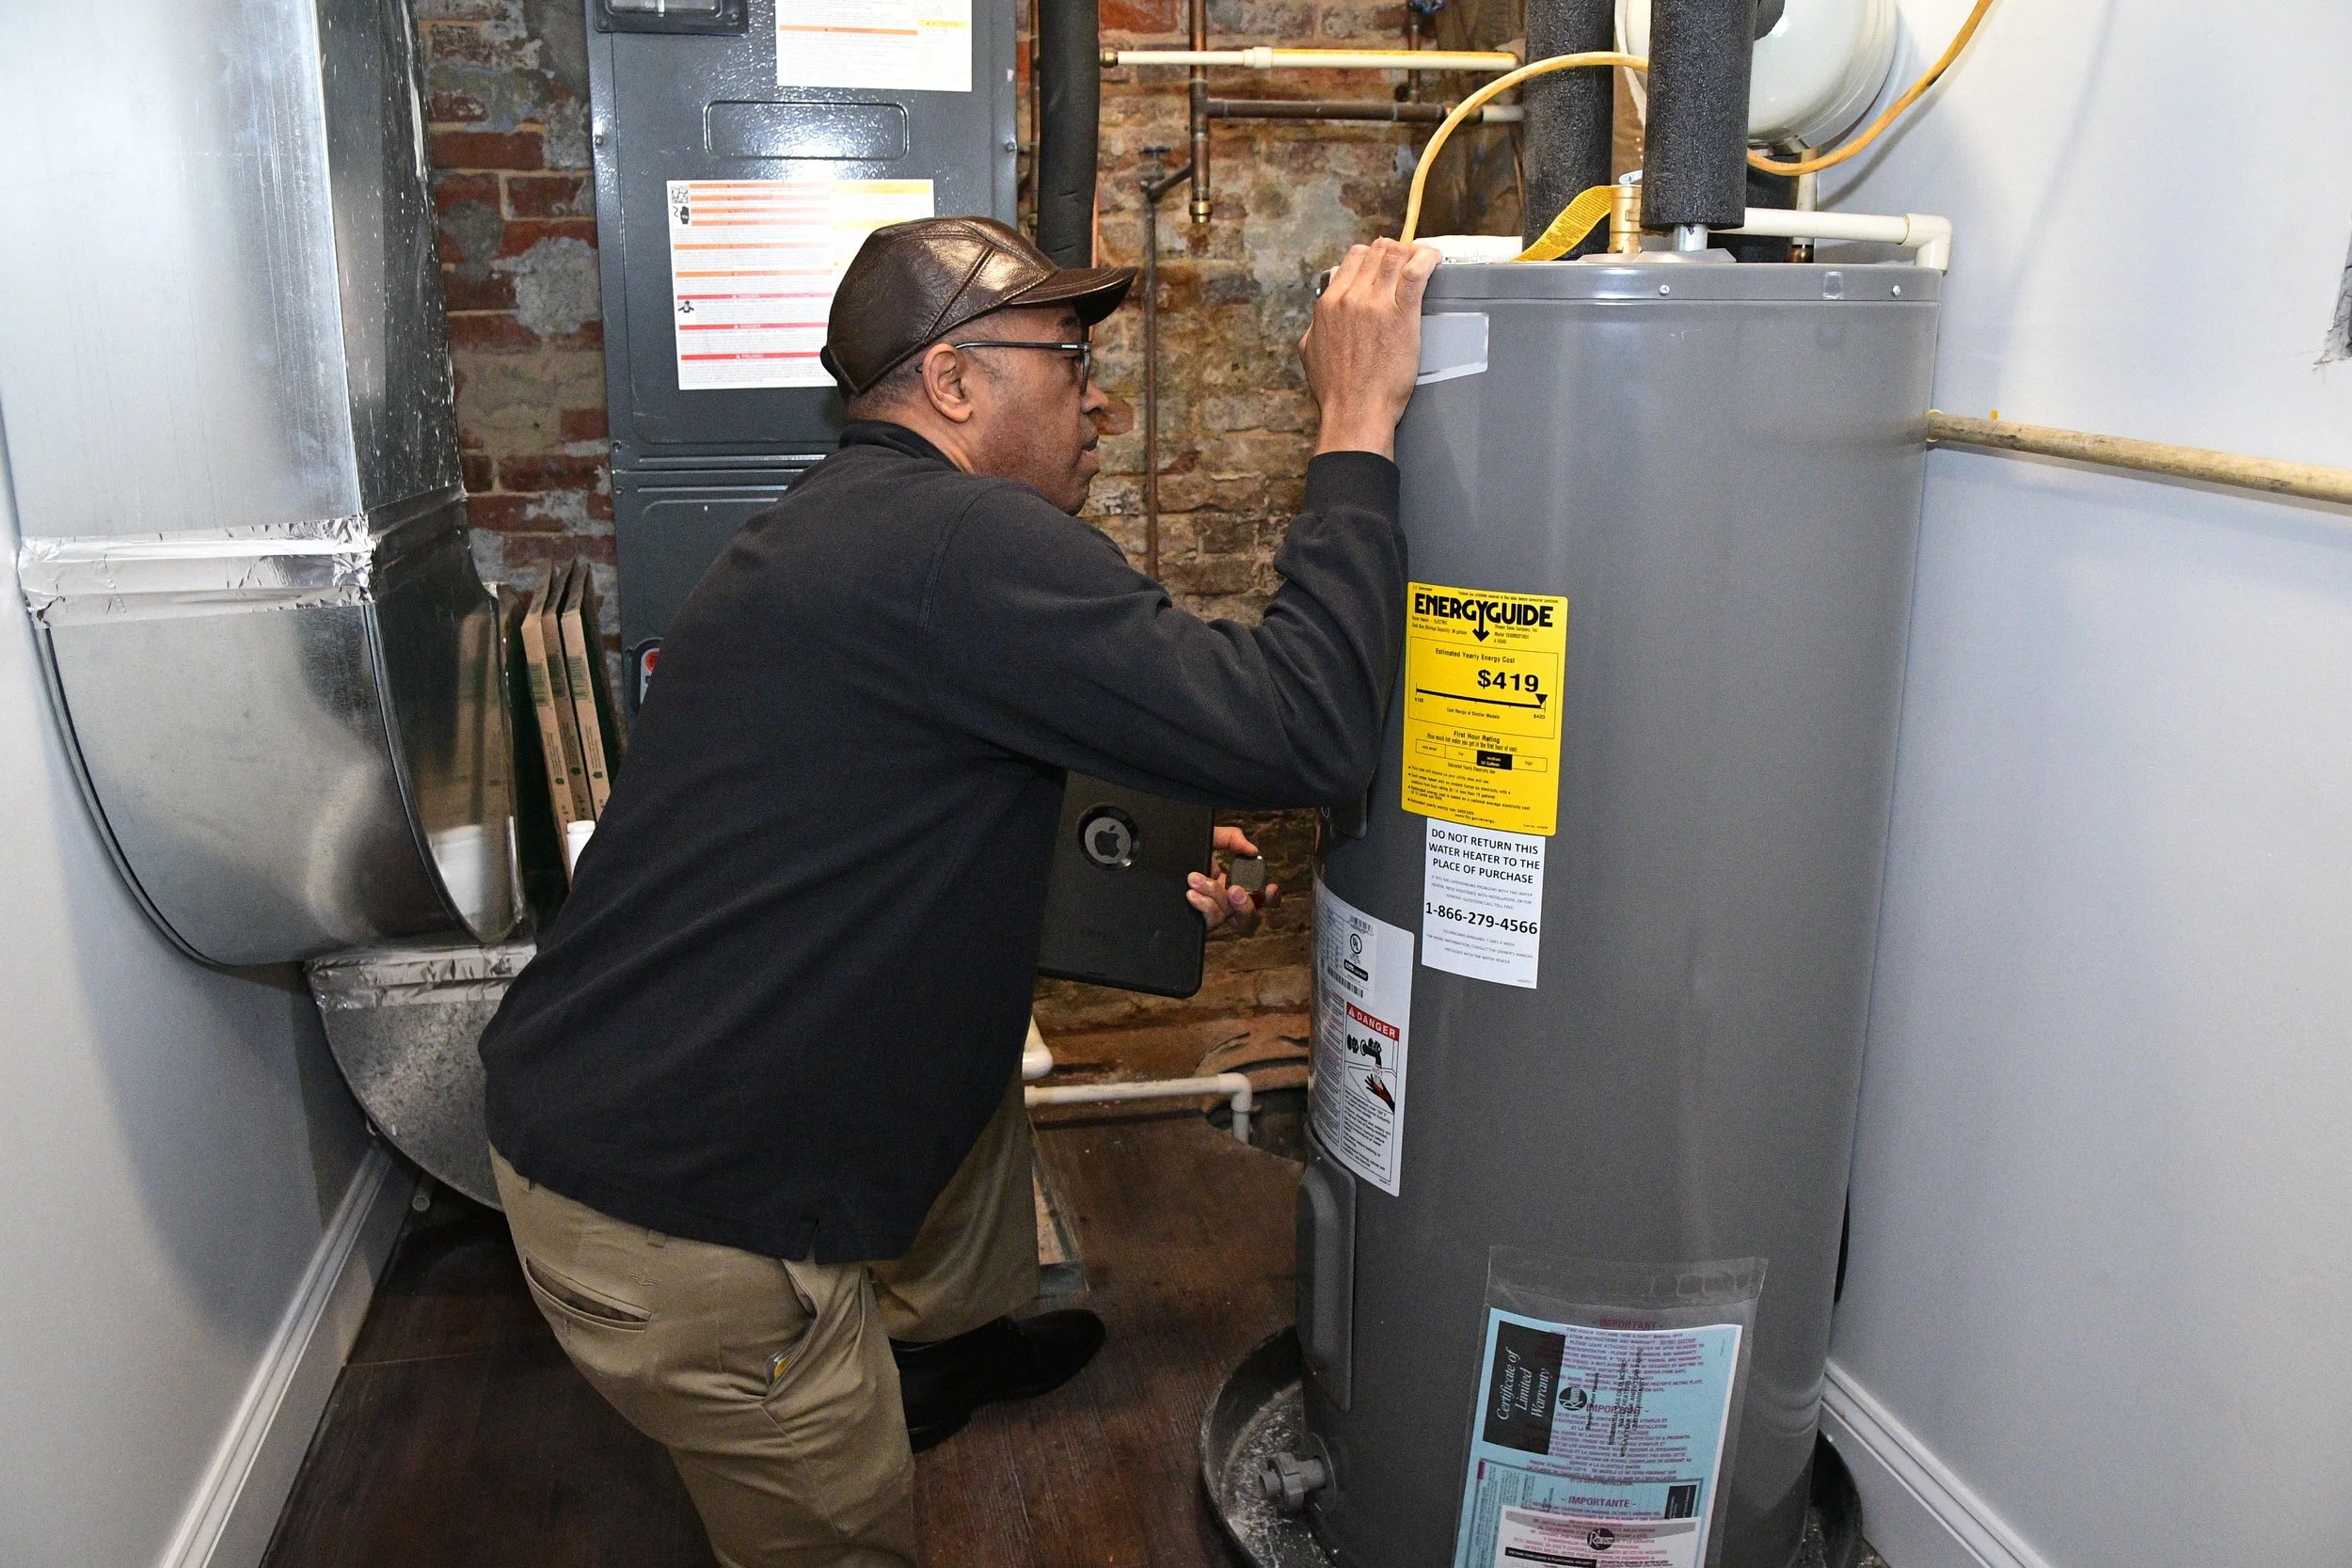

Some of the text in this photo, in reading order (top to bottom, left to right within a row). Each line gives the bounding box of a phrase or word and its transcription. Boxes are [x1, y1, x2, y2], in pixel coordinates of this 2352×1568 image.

[1415, 593, 1553, 628] ENERGYGUIDE
[1436, 648, 1460, 657] Estimated
[1462, 651, 1479, 661] Yearly
[1481, 653, 1501, 663] Energy
[1477, 669, 1539, 693] $419
[1482, 735, 1501, 744] Rating
[1431, 829, 1538, 855] DO NOT RETURN THIS
[1428, 842, 1540, 870] WATER HEATER TO THE
[1433, 858, 1534, 884] PLACE OF PURCHASE
[1425, 901, 1537, 934] 1-866-279-4566
[1357, 1011, 1395, 1038] DANGER
[1372, 1067, 1383, 1077] HOT
[1599, 1319, 1657, 1330] IMPORTANT
[1497, 1346, 1521, 1420] Certificate of
[1515, 1367, 1533, 1411] Limited
[1531, 1368, 1553, 1418] Warranty
[1559, 1386, 1583, 1409] Rheem
[1568, 1496, 1629, 1508] IMPORTANTE
[1588, 1530, 1613, 1547] Rheem
